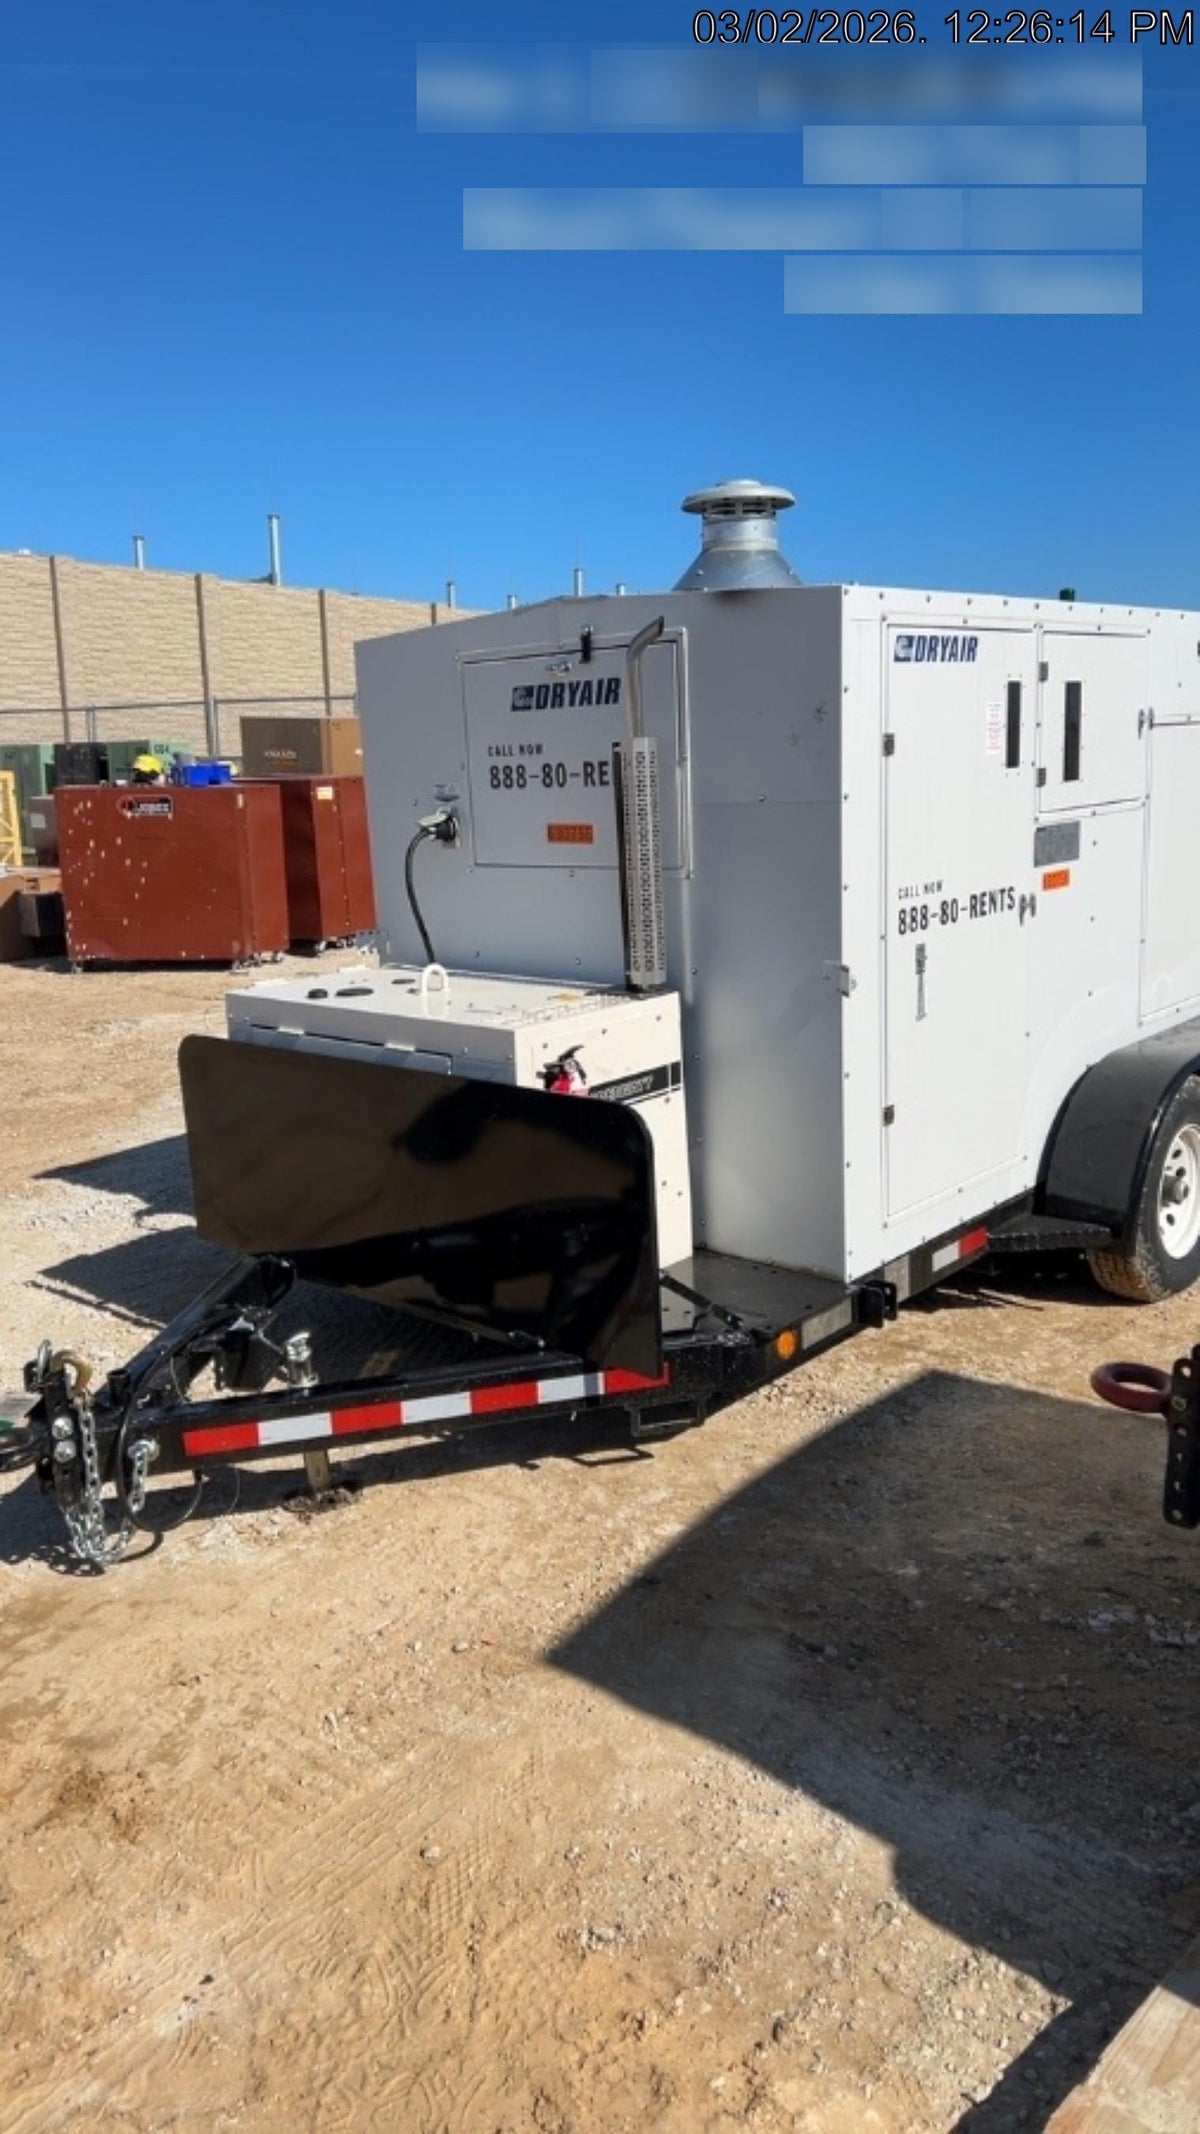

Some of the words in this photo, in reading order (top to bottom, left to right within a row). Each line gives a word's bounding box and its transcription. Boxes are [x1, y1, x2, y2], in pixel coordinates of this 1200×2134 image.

[915, 634, 979, 662] DRYAIR
[535, 677, 621, 710] DRYAIR
[488, 744, 515, 757] CALL
[518, 743, 544, 756] NOW
[489, 760, 611, 790] 888-80-RE
[898, 884, 921, 900] CALL
[923, 879, 943, 895] NOW
[898, 885, 1016, 936] 888-80-RENTS
